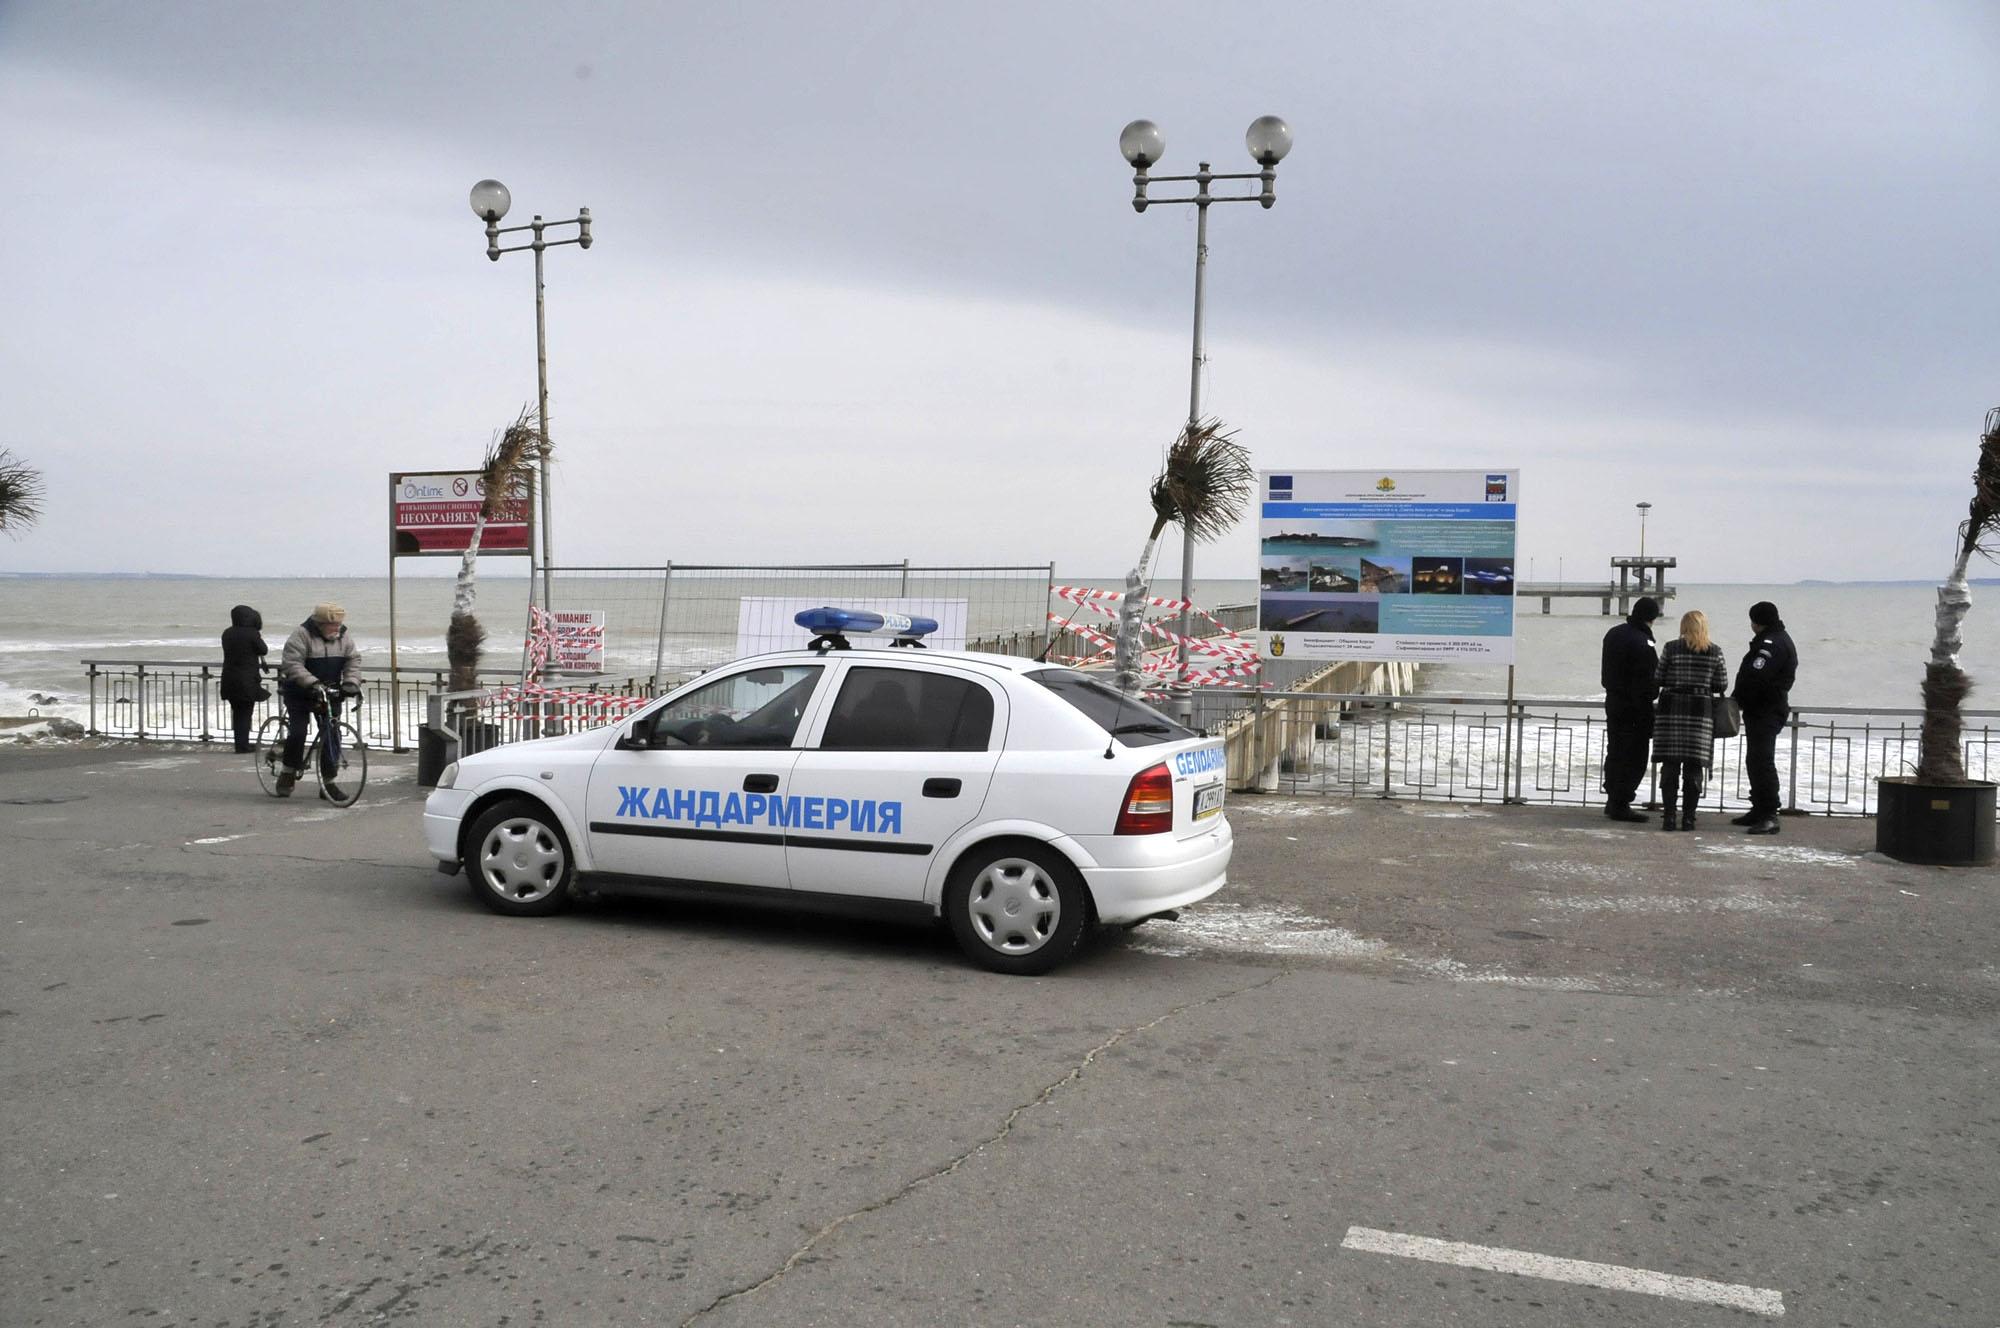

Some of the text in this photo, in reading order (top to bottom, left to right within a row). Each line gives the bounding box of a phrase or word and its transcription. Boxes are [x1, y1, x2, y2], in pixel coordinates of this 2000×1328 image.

[400, 511, 480, 524] НЕОХРАНЯЕМ
[555, 613, 592, 623] ИМАНИЕ!
[616, 786, 902, 834] ЖАНДАРМЕРИЯ
